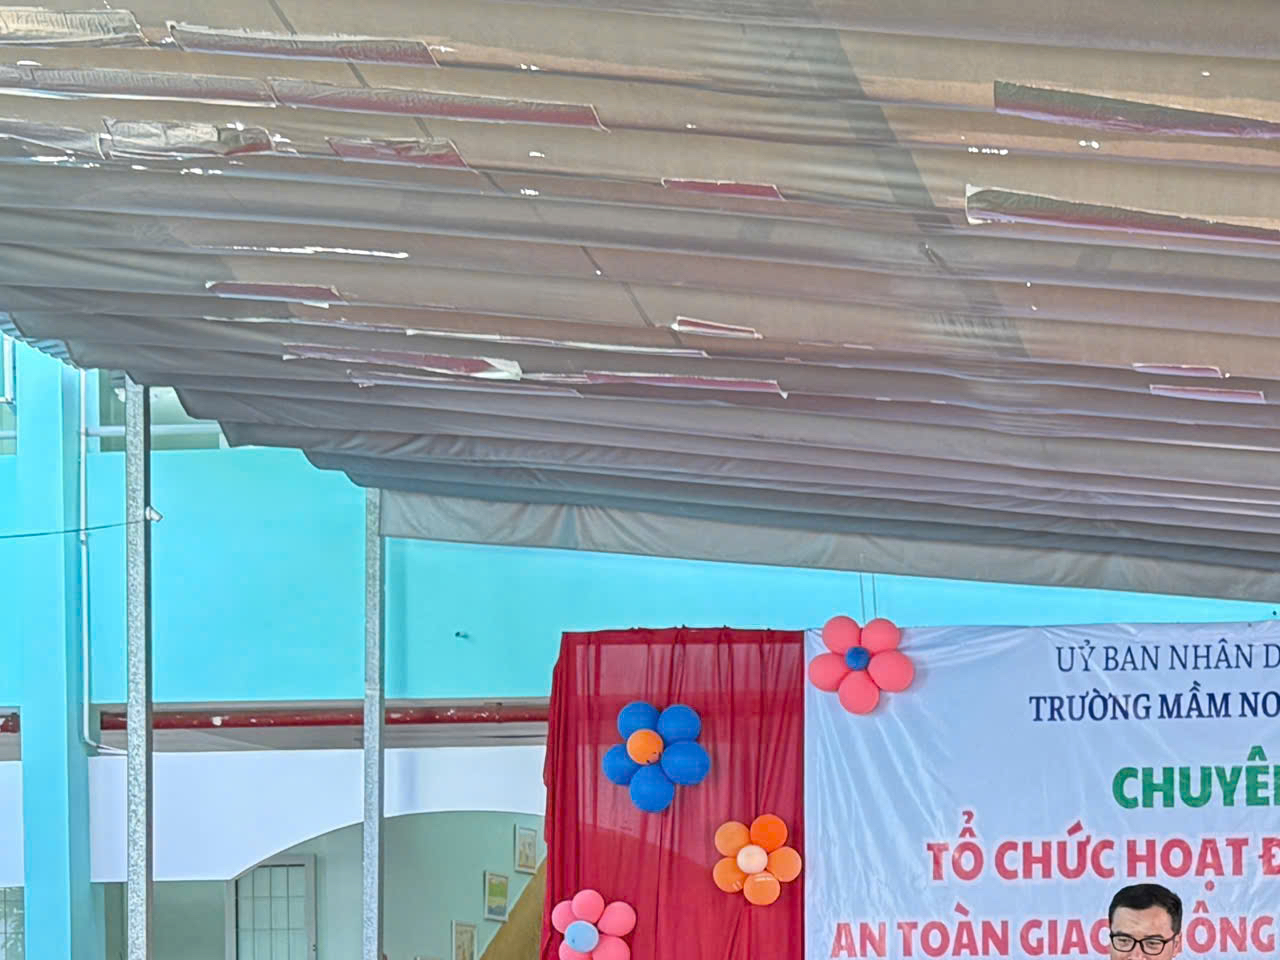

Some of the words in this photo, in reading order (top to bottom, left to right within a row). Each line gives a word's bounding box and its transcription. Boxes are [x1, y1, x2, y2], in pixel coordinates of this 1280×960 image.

[1056, 639, 1096, 672] UỶ
[1102, 645, 1160, 671] BAN
[1169, 638, 1253, 670] NHÂN
[1029, 688, 1152, 722] TRƯỜNG
[1158, 681, 1231, 719] MẦM
[927, 810, 984, 881] TỔ
[995, 820, 1115, 880] CHỨC
[1127, 838, 1248, 892] HOẠT
[830, 922, 887, 958] AN
[897, 902, 1009, 958] TOÀN
[1186, 900, 1275, 953] ÔNG
